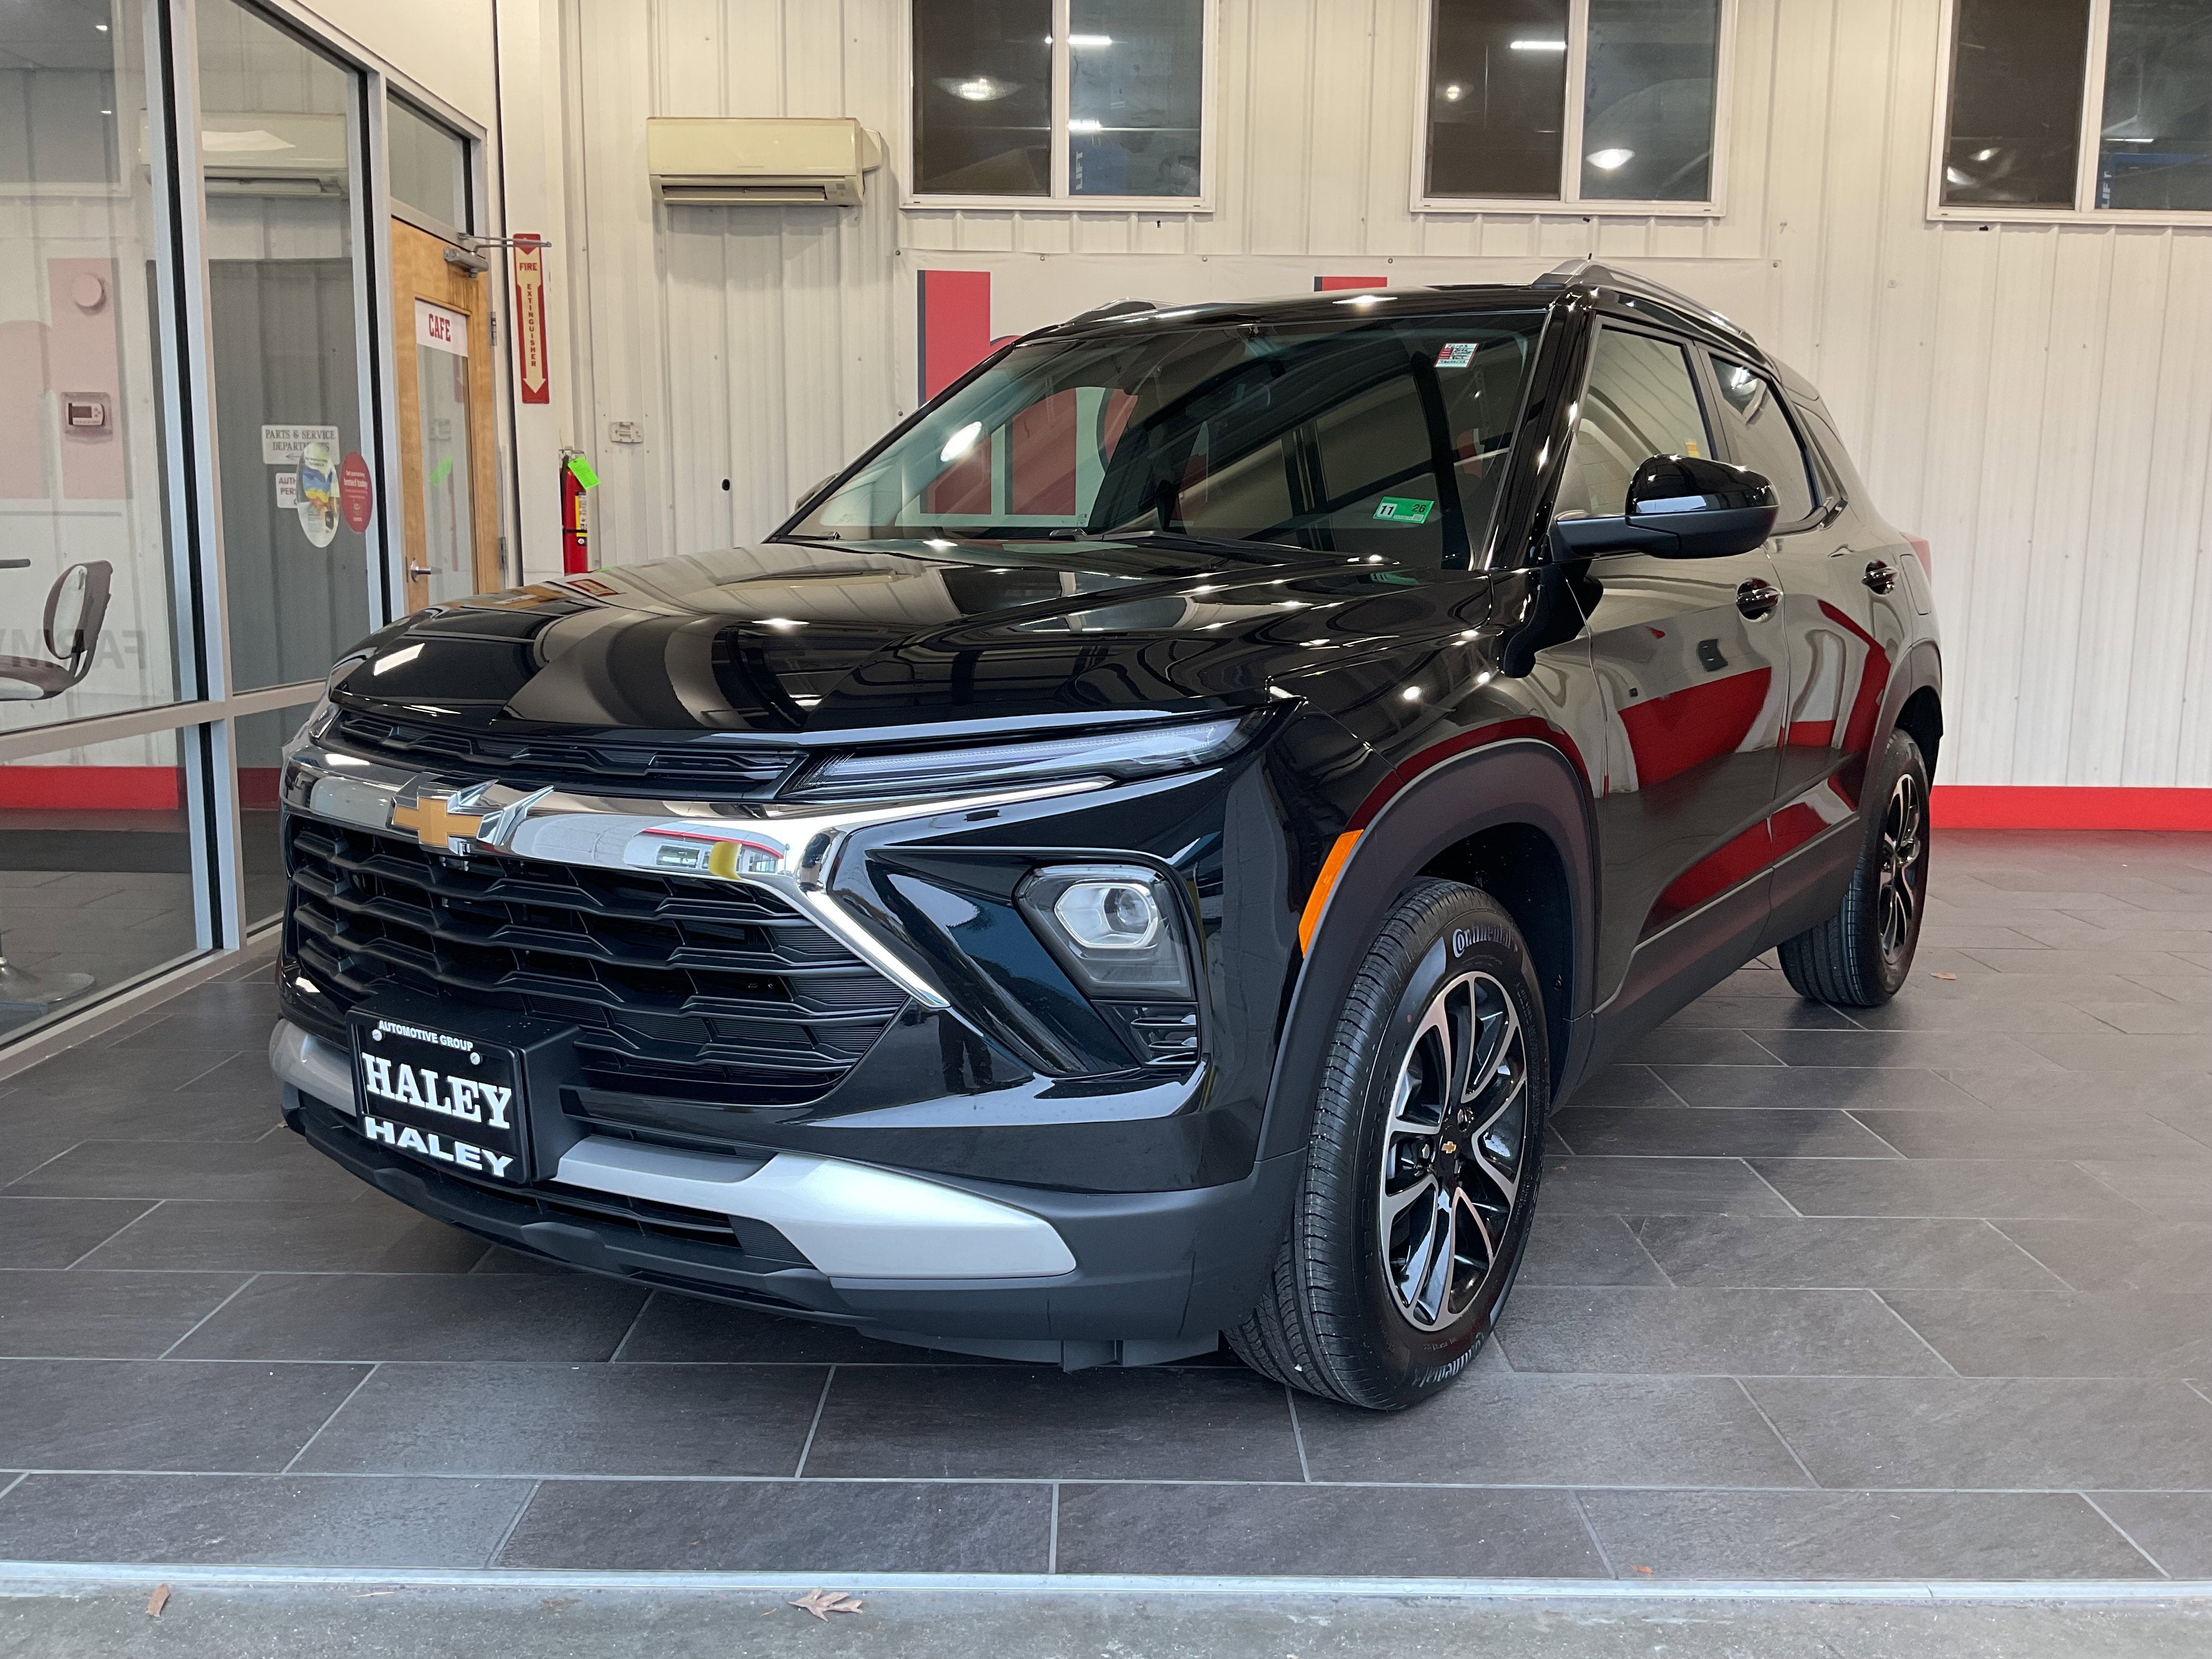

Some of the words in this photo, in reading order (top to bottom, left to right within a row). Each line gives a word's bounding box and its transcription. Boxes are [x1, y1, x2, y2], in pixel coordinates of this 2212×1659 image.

[520, 262, 538, 271] FIRE
[428, 313, 451, 342] CAFE
[527, 283, 536, 367] EXTINGUISHER
[266, 430, 290, 439] PARTS
[293, 430, 299, 438] &
[302, 430, 335, 439] SERVICE
[273, 442, 330, 452] DEPARTS
[1380, 505, 1395, 515] 11
[1412, 504, 1426, 513] 26
[379, 1020, 438, 1043] AUTOMOTIVE
[439, 1034, 473, 1052] GROUP
[362, 1052, 512, 1130] HALEY
[364, 1116, 514, 1178] HALEY
